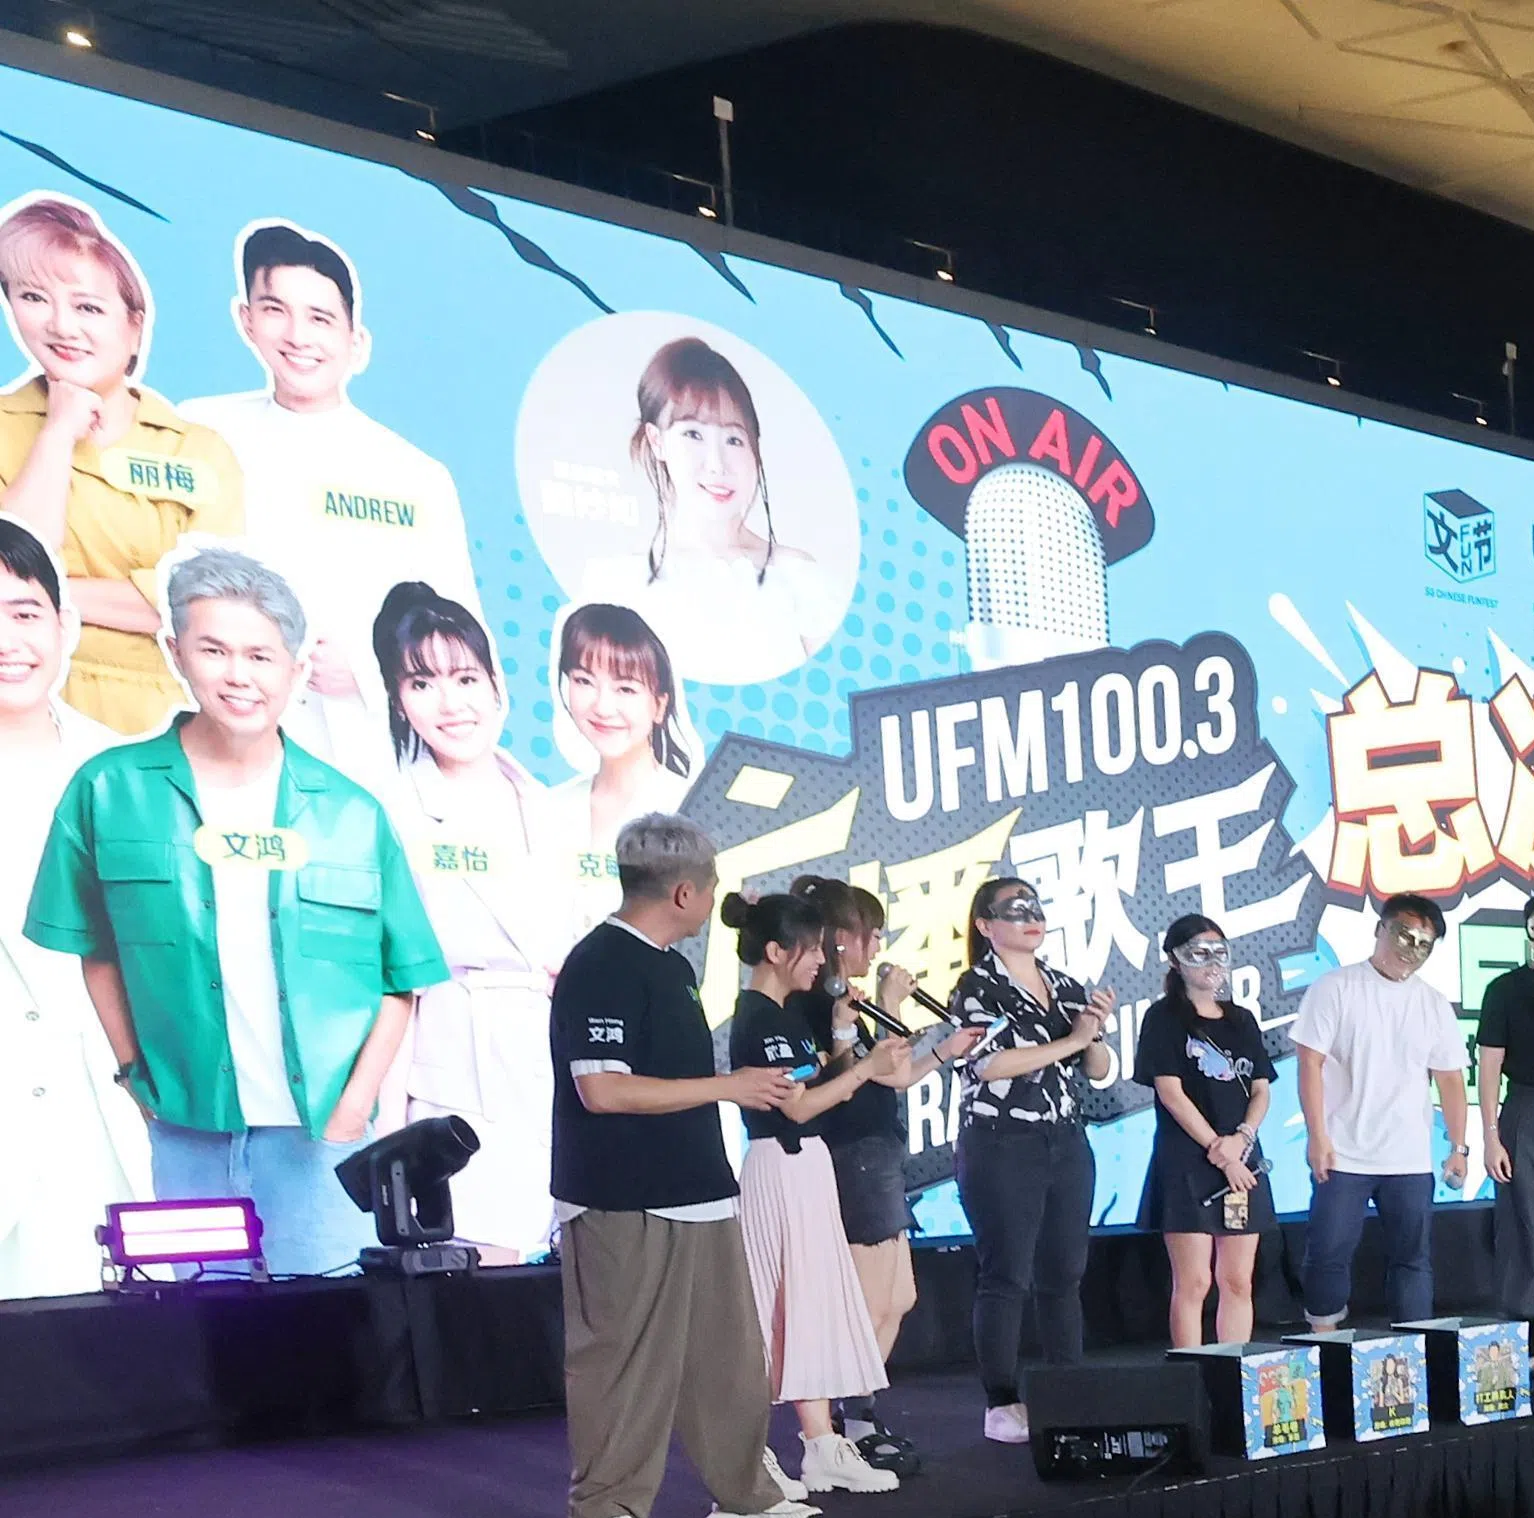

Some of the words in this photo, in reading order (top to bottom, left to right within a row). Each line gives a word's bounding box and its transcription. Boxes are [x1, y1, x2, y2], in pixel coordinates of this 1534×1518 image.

[128, 456, 197, 496] 丽梅
[928, 397, 1017, 486] ON
[1027, 409, 1140, 529] AIR
[323, 489, 417, 528] ANDREW
[879, 655, 1238, 823] UFM100.3
[222, 832, 287, 863] 文鸿
[432, 843, 489, 873] 嘉怡
[588, 1025, 624, 1045] 文鸿
